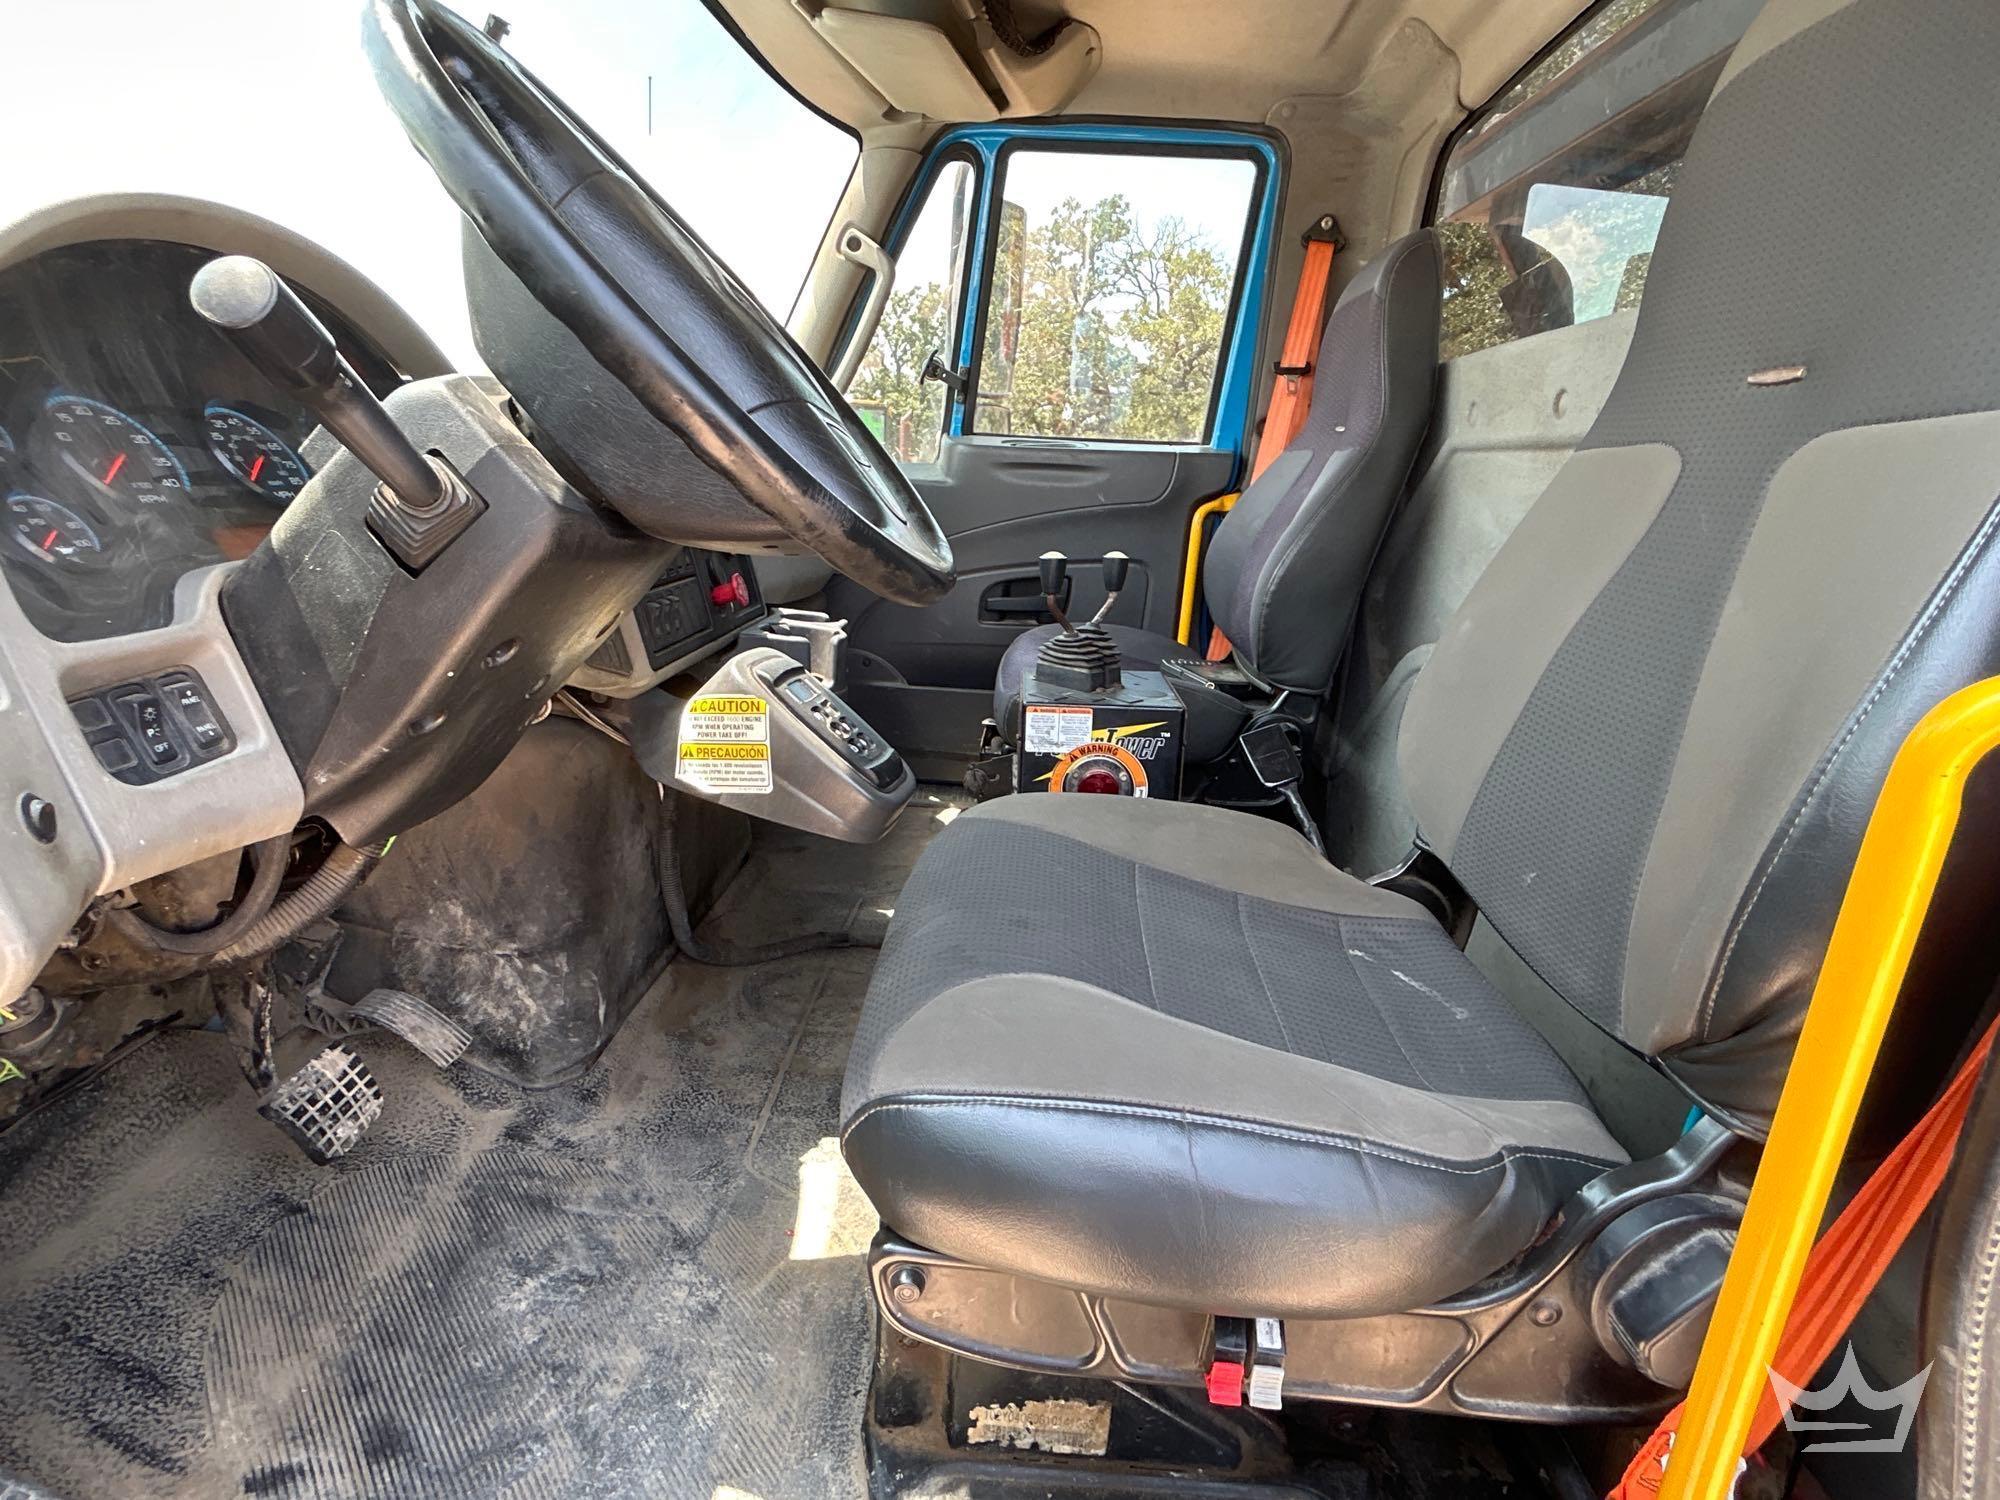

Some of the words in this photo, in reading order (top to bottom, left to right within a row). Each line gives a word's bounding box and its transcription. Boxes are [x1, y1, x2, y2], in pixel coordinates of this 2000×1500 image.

[161, 478, 181, 488] 40
[137, 494, 169, 504] RPM
[181, 695, 201, 705] PANEL
[700, 700, 760, 712] CAUTION
[195, 722, 217, 733] PANEL
[153, 742, 169, 753] OFF
[1078, 744, 1119, 757] WARNING
